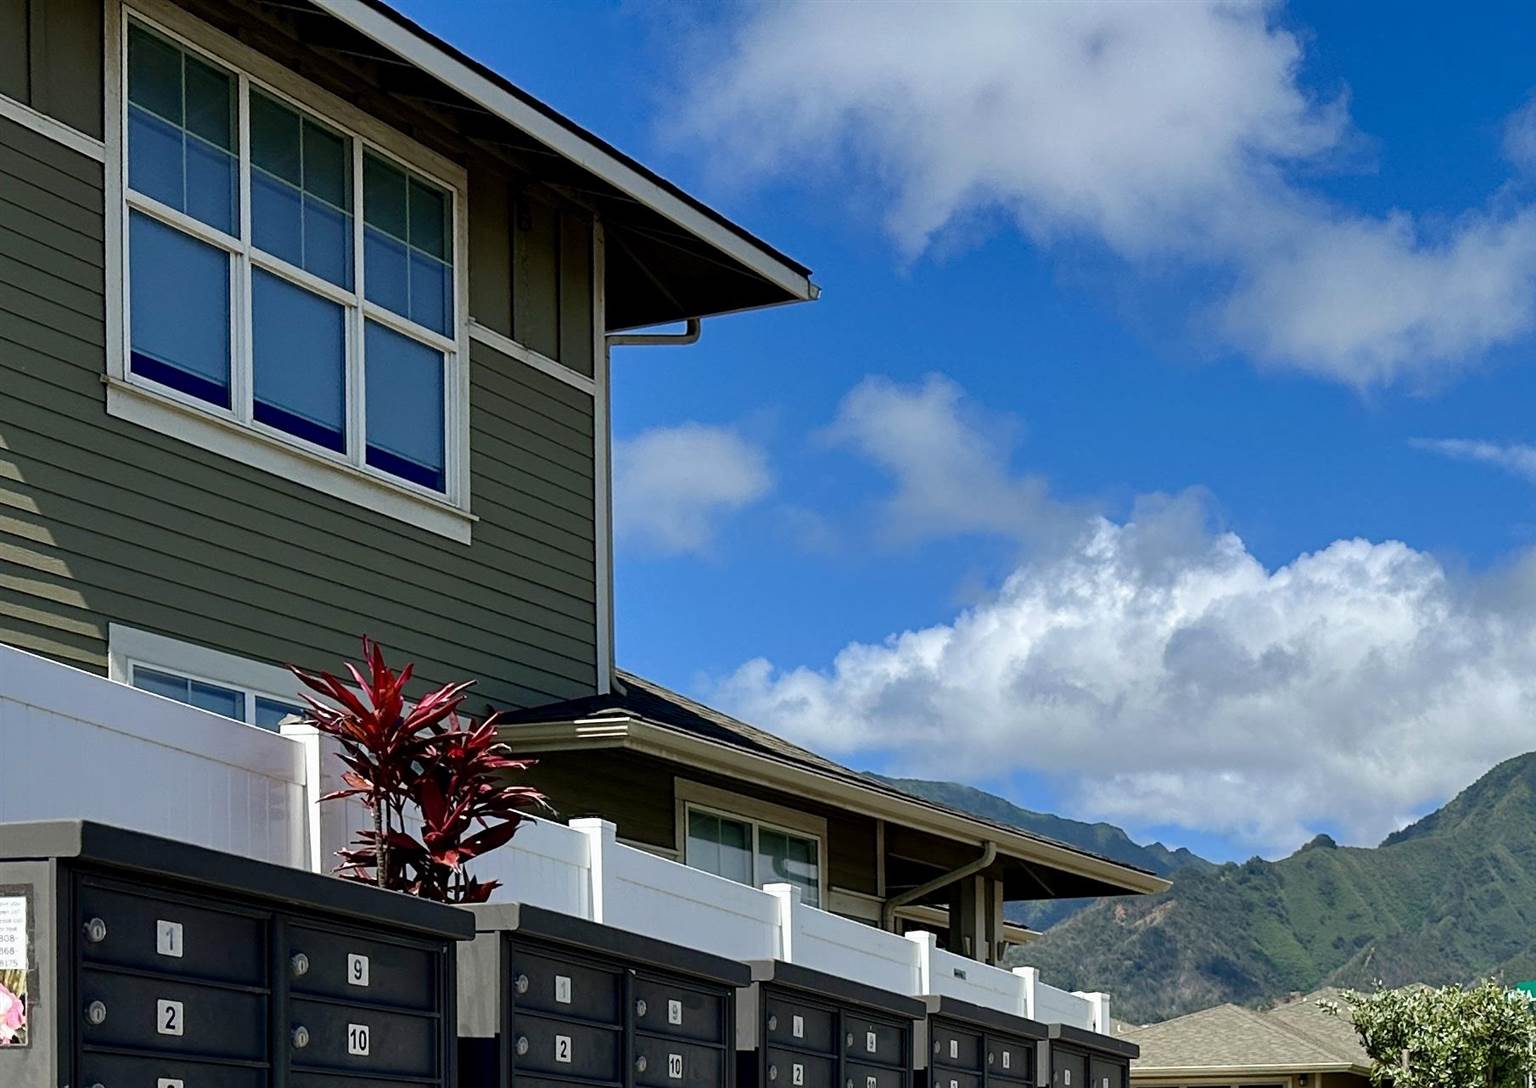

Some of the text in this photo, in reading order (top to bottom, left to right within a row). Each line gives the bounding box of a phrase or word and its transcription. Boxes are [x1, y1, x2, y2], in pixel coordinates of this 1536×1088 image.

[166, 927, 173, 950] 1
[354, 959, 363, 980] 9
[560, 982, 566, 999] 1
[166, 1006, 175, 1030] 2
[351, 1029, 367, 1051] 10
[560, 1040, 567, 1058] 2
[670, 1058, 680, 1075] 10
[796, 1067, 801, 1081] 2
